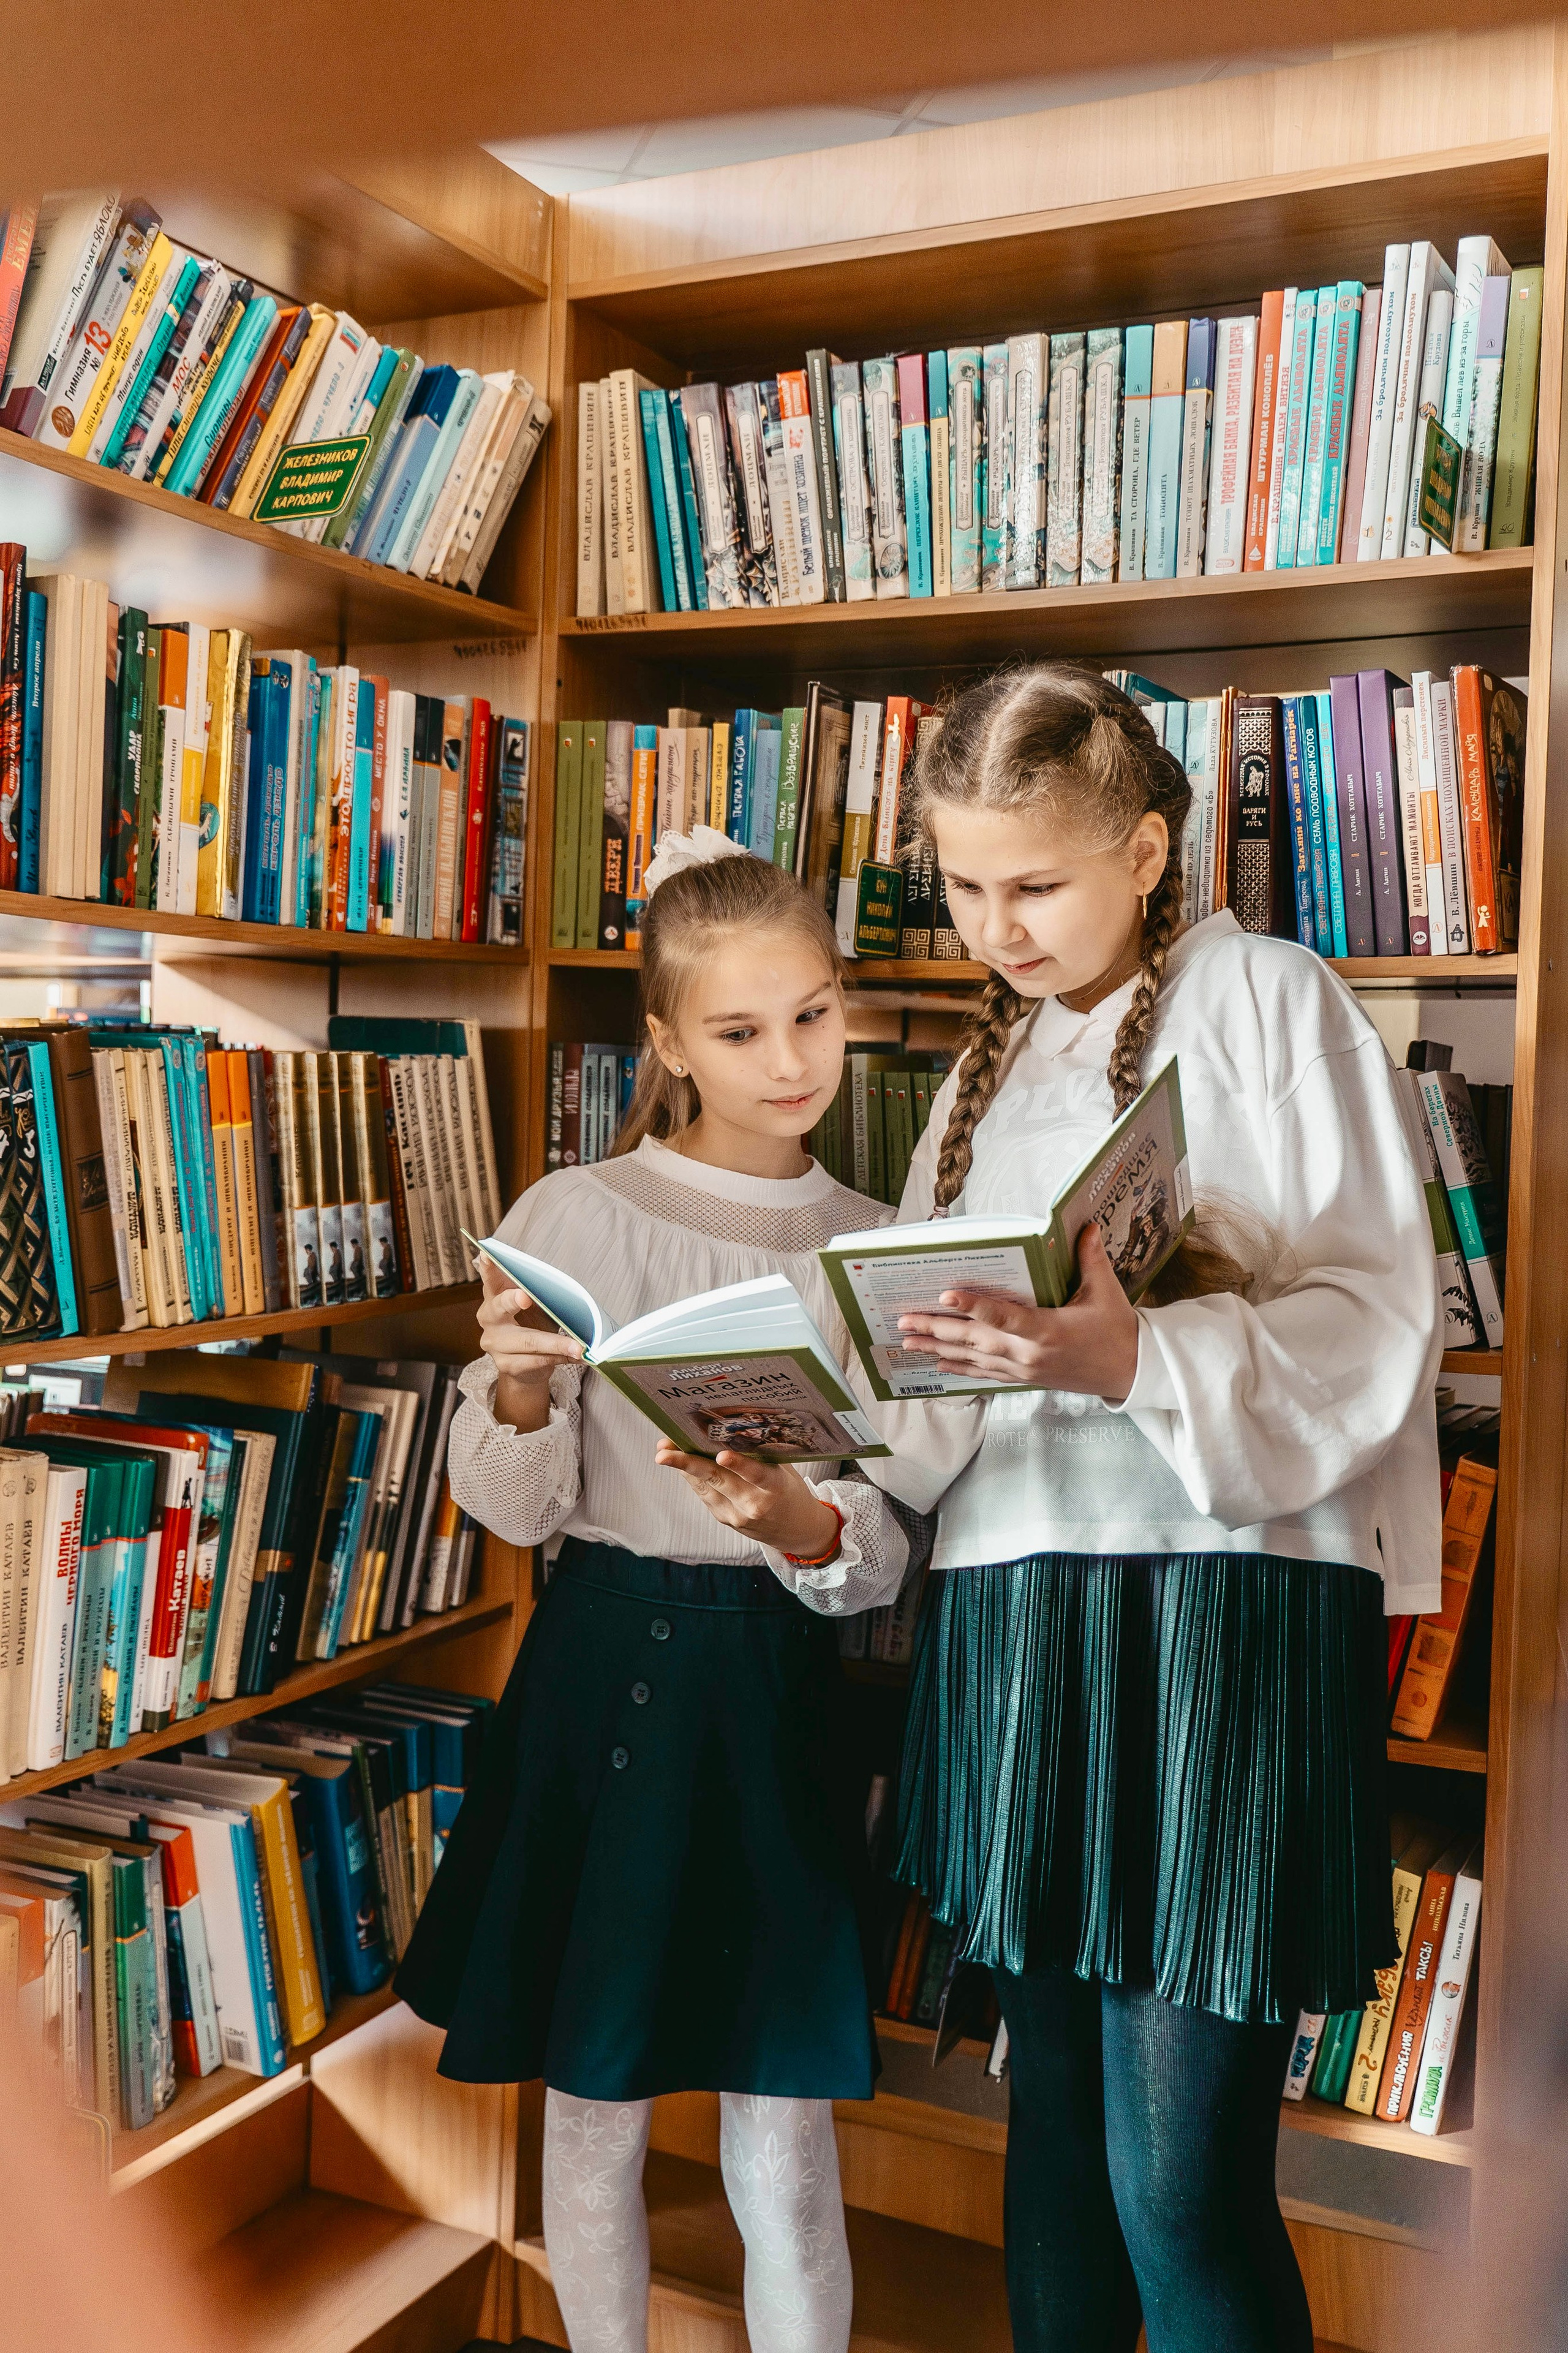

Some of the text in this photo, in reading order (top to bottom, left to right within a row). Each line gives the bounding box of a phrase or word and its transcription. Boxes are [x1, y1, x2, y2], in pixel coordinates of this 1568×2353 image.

[78, 319, 116, 356] 13
[1460, 319, 1474, 344] горы
[61, 347, 94, 402] Гимназия
[1375, 290, 1396, 421] За бродячим подсолнухом
[1396, 292, 1419, 423] За бродячим подсолнухом
[1327, 319, 1350, 460] КРАСНЫЕ ДЬЯВОЛЯТА
[1457, 369, 1466, 385] лев
[1257, 353, 1274, 482] ШТУРМАН КОНОПЛЁВ
[1450, 386, 1465, 418] Вышел
[1272, 366, 1289, 512] КРАПИВИН ШЛЕМ ВИТЯЗЯ
[1287, 406, 1302, 467] КРАСНЫЕ
[279, 469, 344, 490] ВЛАДИМИР
[282, 448, 359, 470] ЖЕЛЕЗНИКОВ
[582, 391, 597, 561] ВЛАДИСЛАВ КРАПИВИН
[619, 380, 636, 553] ВЛАДИСЛАВ КРАПИВИН
[271, 490, 334, 510] КАРПОВИЧ
[1471, 531, 1479, 540] В.
[1477, 439, 1487, 463] ВОДА
[608, 474, 620, 559] ВЛАДИСЛАВ
[1130, 510, 1137, 523] ТА
[1251, 493, 1259, 535] ВЛАДИСЛАВ
[31, 675, 40, 708] Второе
[1436, 698, 1449, 731] МАРКИ
[127, 730, 138, 761] УДАР
[1207, 717, 1219, 772] Лада КУТУЗОВА
[1306, 727, 1316, 758] КОТОВ
[1419, 723, 1429, 759] Лисиный
[131, 733, 145, 795] СКОРПИОНА
[343, 730, 357, 796] ПРОСТО
[1291, 764, 1299, 779] на
[1437, 733, 1453, 803] ПОХИЩЕННОЙ
[1292, 782, 1302, 804] мне
[1308, 759, 1320, 817] ПОДВОДНЫХ
[1346, 773, 1357, 811] ХОТТАБЫЧ
[1374, 771, 1385, 809] ХОТТАБЫЧ
[1466, 766, 1483, 822] КАЛЕНДАРЬ
[339, 803, 352, 837] ЭТО
[1294, 807, 1302, 823] ко
[1312, 818, 1322, 844] СЕМЬ
[1348, 812, 1359, 842] СТАРИК
[1377, 810, 1387, 840] СТАРИК
[1444, 804, 1457, 849] ПОИСКАХ
[1205, 845, 1212, 855] из
[1404, 790, 1423, 907] КОГДА ОТТАИВАЮТ МАМОНТЫ
[1447, 862, 1460, 905] Лёвшин
[1451, 905, 1460, 916] В.
[1423, 1084, 1440, 1127] На берегах
[1438, 1109, 1454, 1147] Северной
[1100, 1138, 1158, 1231] ремя
[657, 1372, 792, 1400] Магазин
[668, 1364, 744, 1382] Лиханов
[704, 1381, 799, 1401] ненаглядных
[740, 1388, 804, 1403] пособий
[72, 1487, 85, 1532] МОРЯ
[2, 1522, 15, 1581] КАТАЕВ
[55, 1519, 74, 1579] ВОЛНЫ
[15, 1519, 34, 1666] ВАЛЕНТИН КАТАЕВ
[167, 1548, 186, 1612] Катаев
[58, 1622, 69, 1669] КАТАЕВ
[1385, 1939, 1434, 2117] ПРИКЛЮЧЕНИЯ ТАКСЫ
